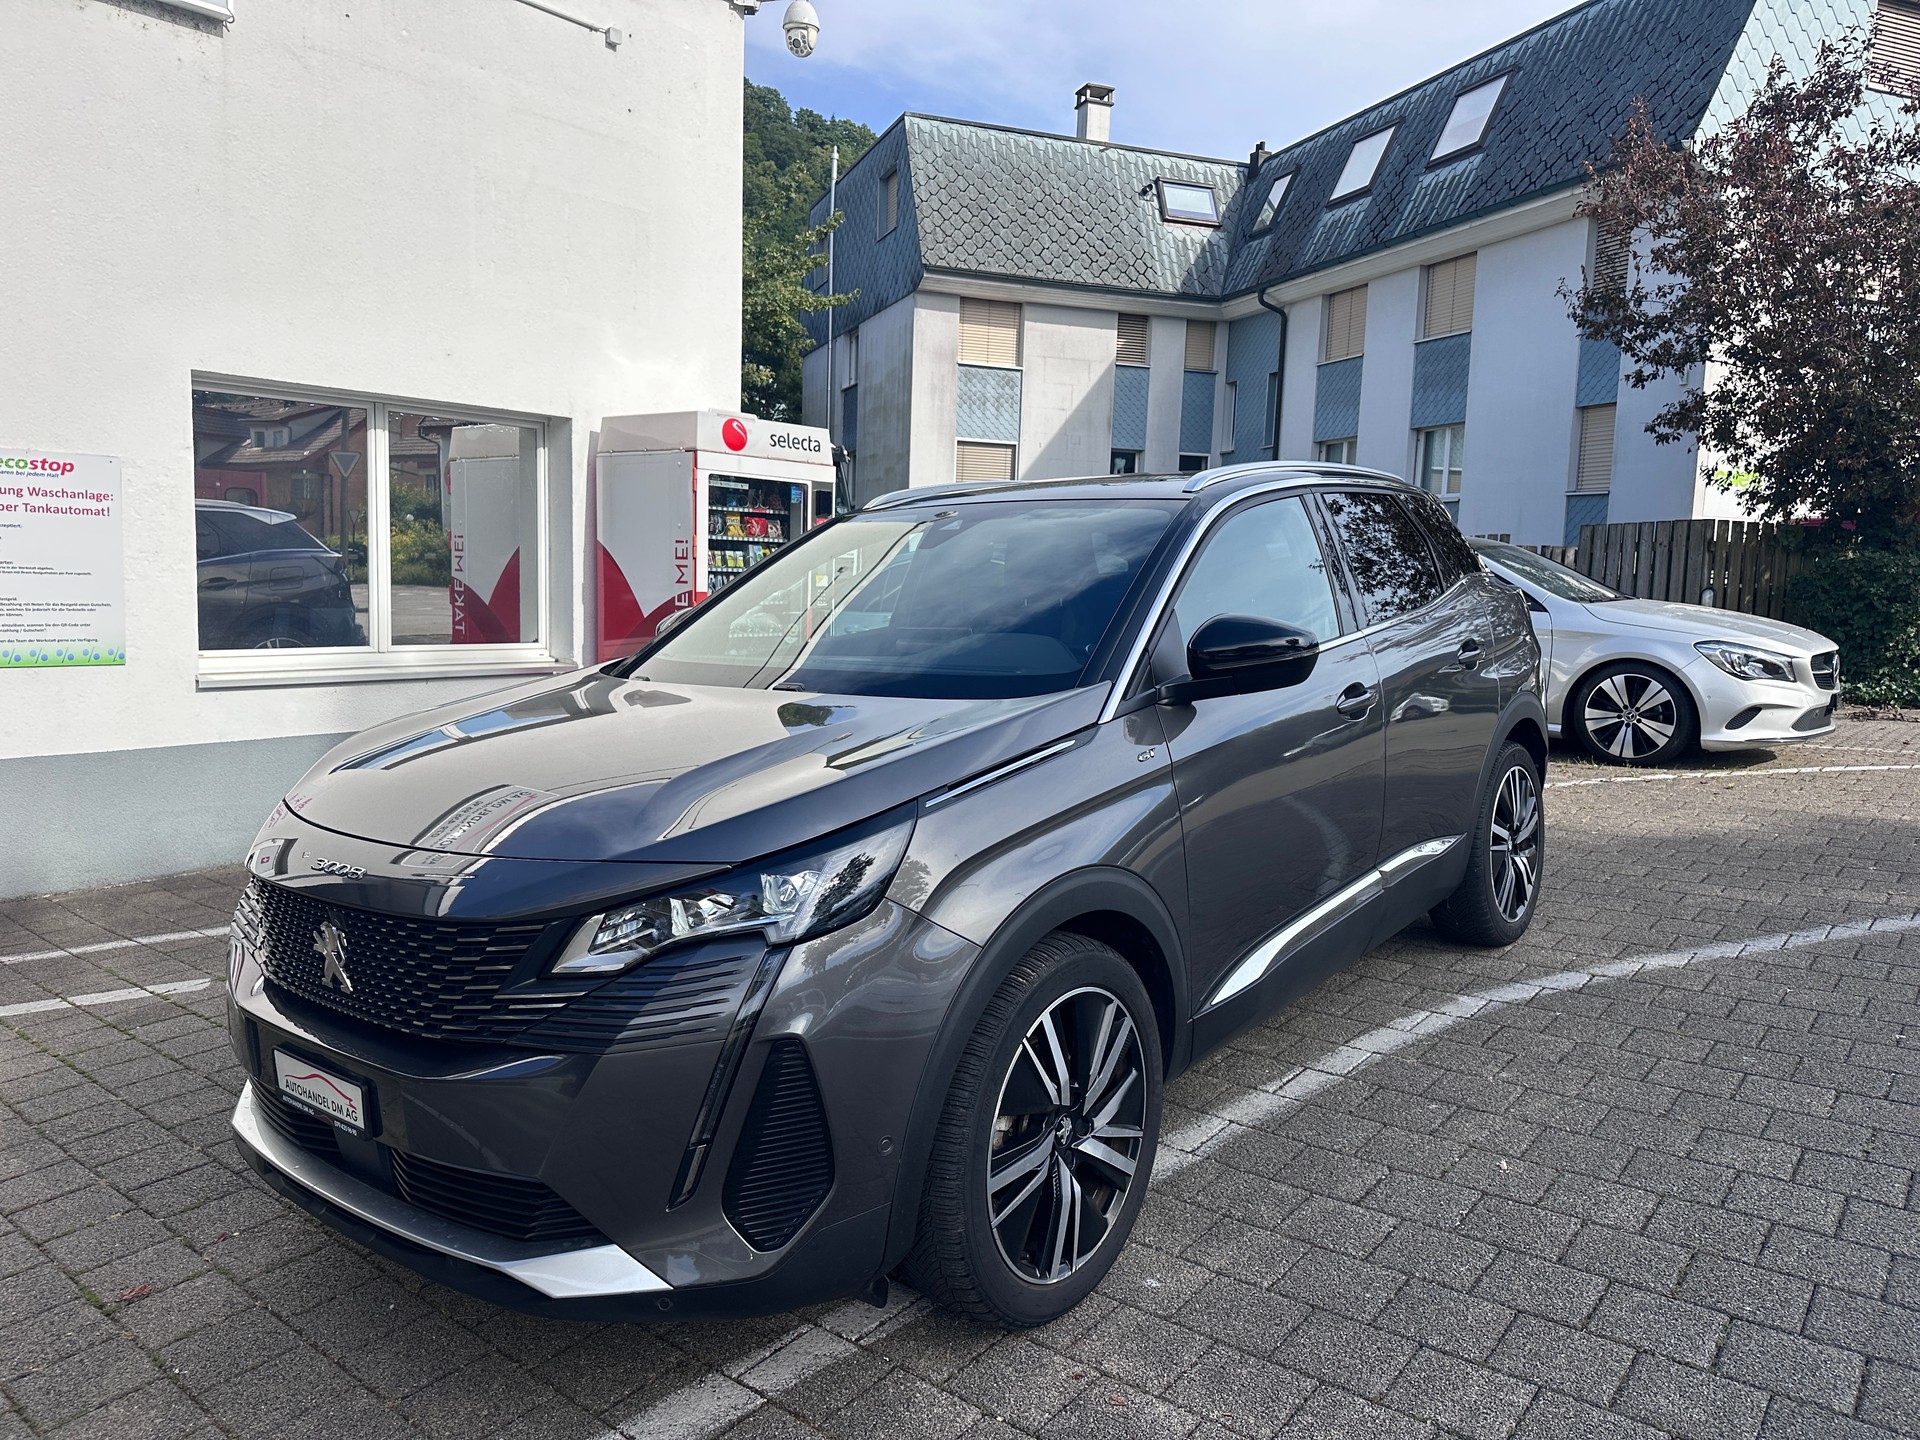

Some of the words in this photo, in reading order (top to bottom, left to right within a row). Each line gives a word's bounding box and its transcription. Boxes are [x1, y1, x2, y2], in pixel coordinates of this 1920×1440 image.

[769, 432, 821, 453] selecta
[27, 486, 114, 502] Waschanlage:
[22, 502, 111, 517] Tankautomat!
[675, 539, 689, 585] ME!
[310, 857, 367, 880] 3008
[285, 1078, 330, 1110] AUTOHANDEL
[331, 1100, 345, 1117] DM
[345, 1107, 358, 1122] AG
